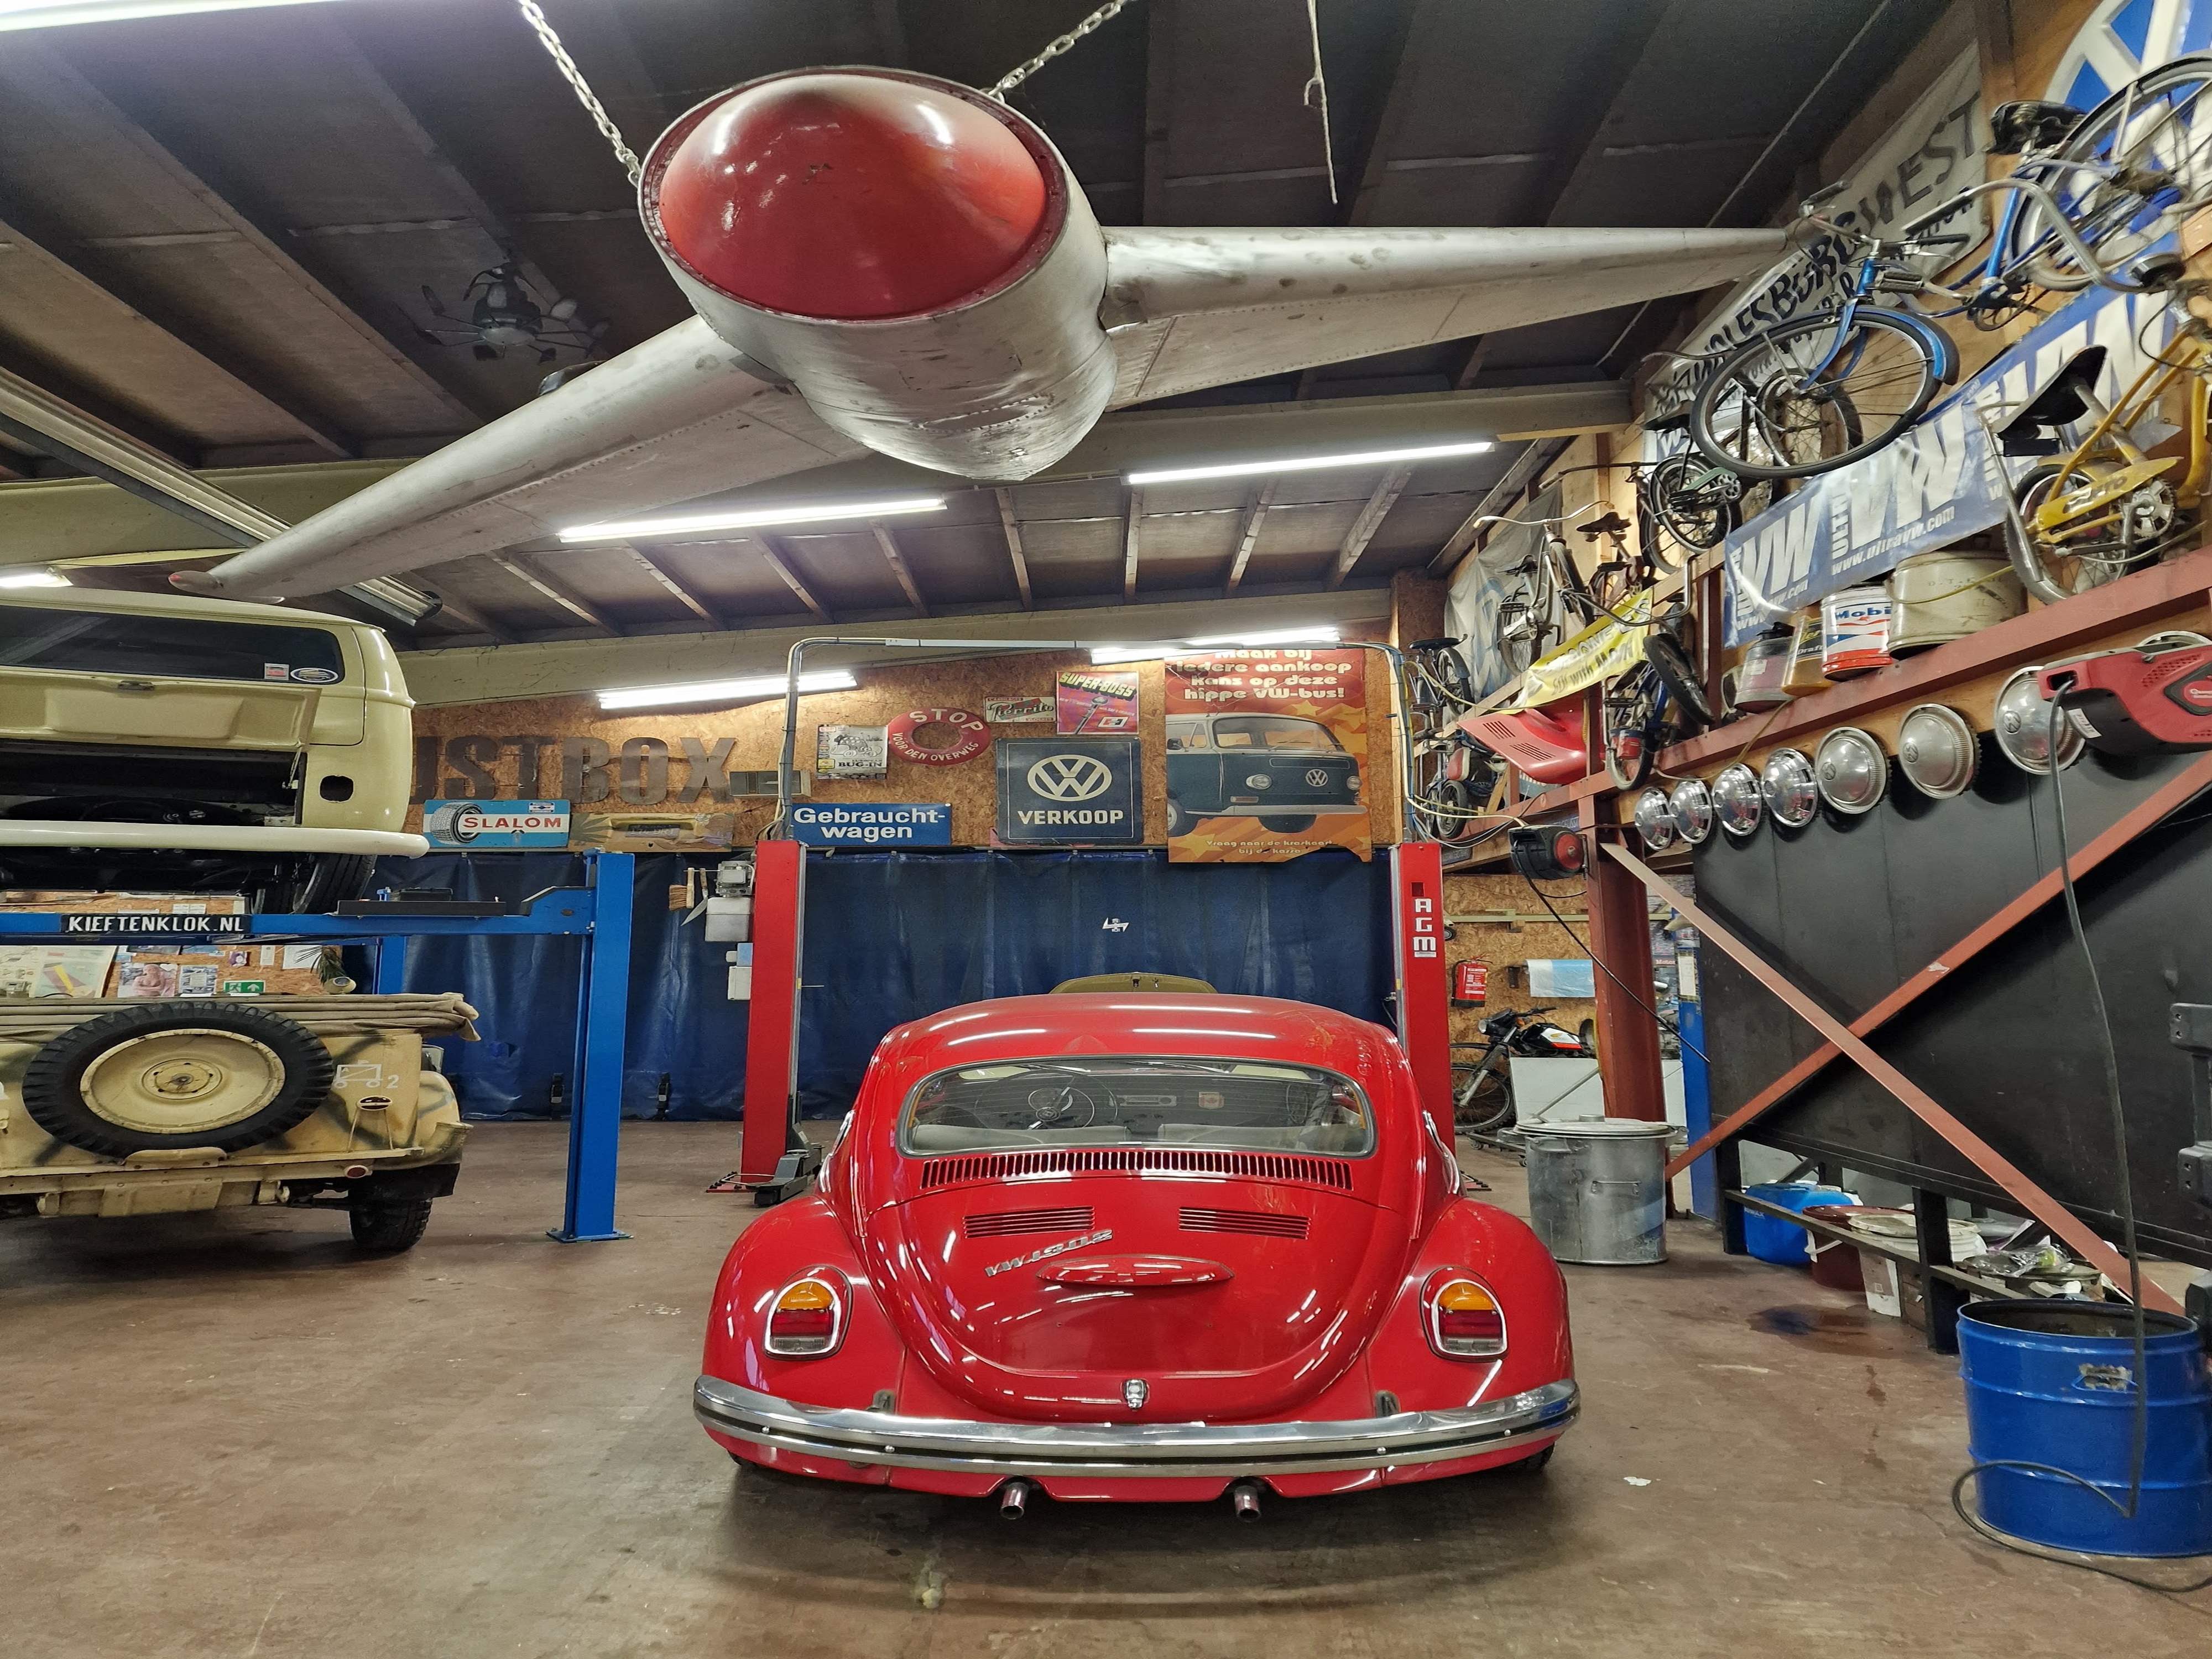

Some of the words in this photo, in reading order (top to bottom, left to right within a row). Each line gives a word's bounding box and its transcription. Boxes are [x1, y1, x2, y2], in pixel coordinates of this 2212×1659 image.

[1851, 403, 1965, 551] VW
[1743, 491, 1823, 596] VW
[1832, 505, 1955, 576] www.ultravw.com
[1835, 606, 1892, 620] Mobi
[1214, 649, 1277, 659] Maak
[1176, 661, 1249, 672] iedere
[1255, 661, 1352, 674] aankoop
[1058, 672, 1137, 700] SUPER-BOSS
[1191, 675, 1243, 686] kans
[1249, 676, 1278, 688] op
[1285, 675, 1338, 686] deze
[1184, 687, 1248, 702] hippe
[1253, 687, 1345, 699] VW-bus!
[909, 708, 984, 731] STOP
[987, 702, 1054, 722] Pierrito
[904, 748, 928, 760] DEN
[930, 742, 979, 761] OVERWEG
[1027, 754, 1113, 802] VW
[463, 817, 562, 828] SLALOM
[794, 807, 946, 824] Gebraucht-
[1018, 810, 1124, 825] VERKOOP
[820, 826, 912, 843] wagen
[68, 916, 244, 932] KIEFTENKLOK.NL
[1413, 898, 1436, 951] AGM
[386, 1074, 399, 1089] 2
